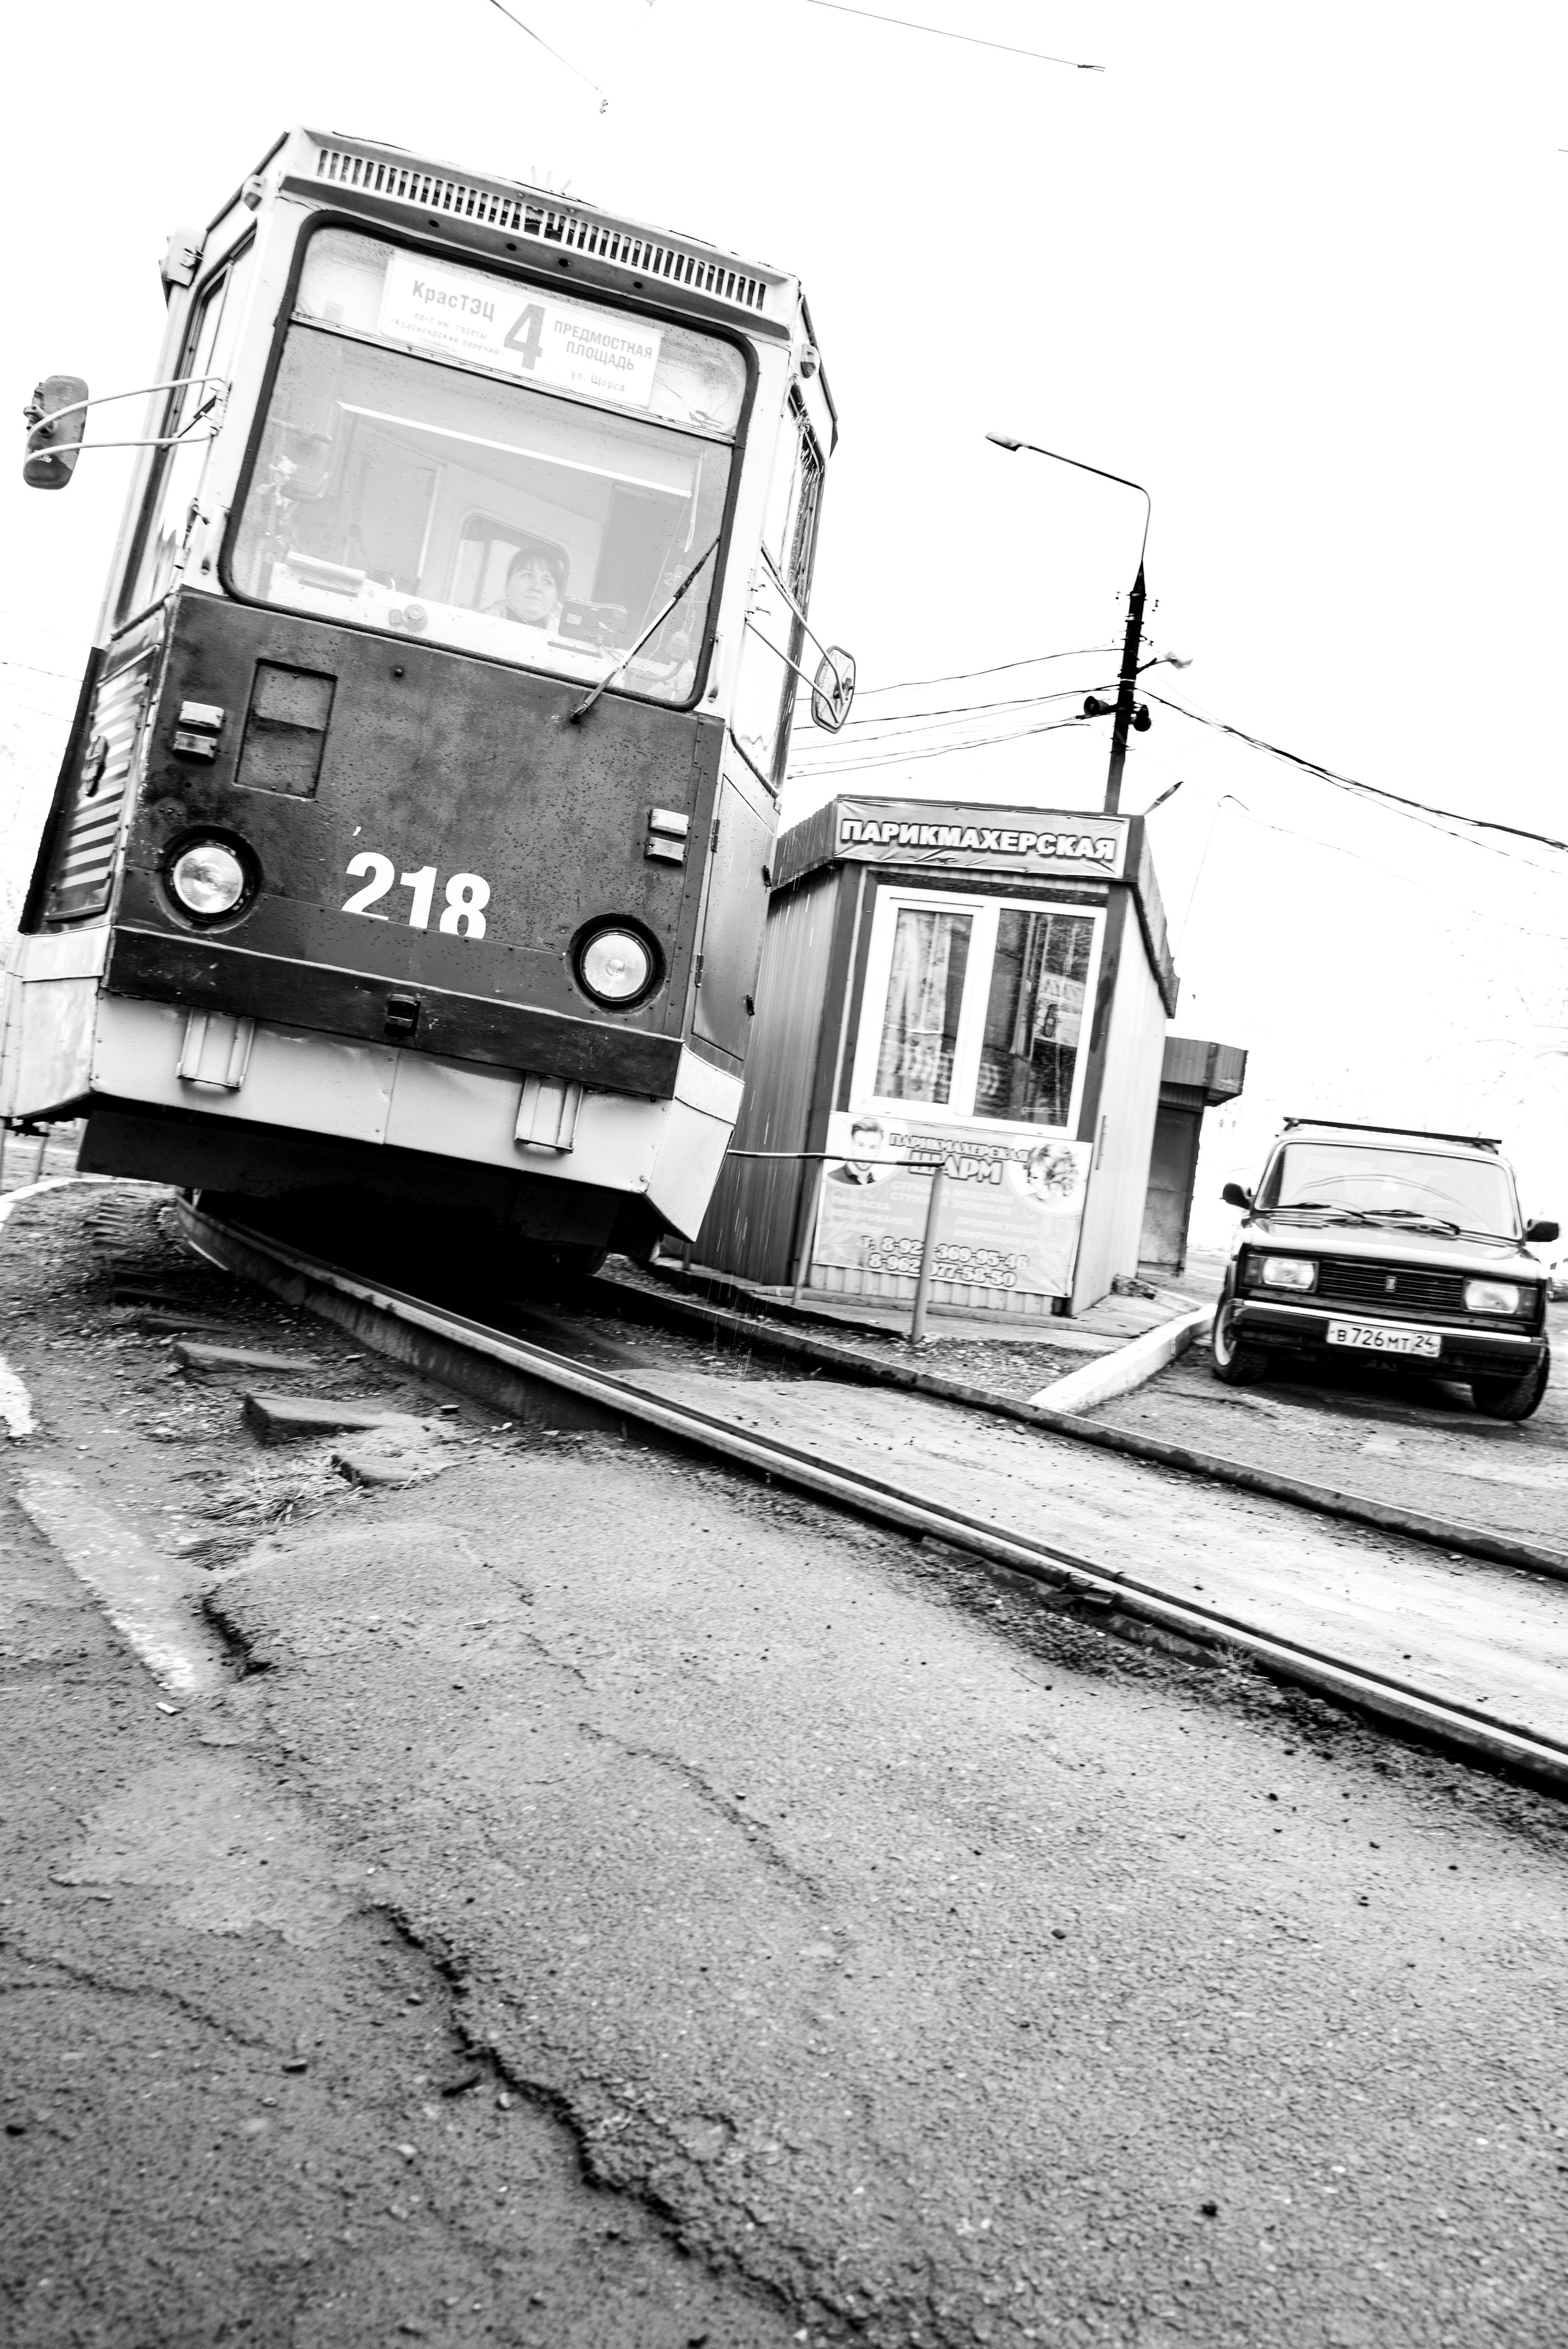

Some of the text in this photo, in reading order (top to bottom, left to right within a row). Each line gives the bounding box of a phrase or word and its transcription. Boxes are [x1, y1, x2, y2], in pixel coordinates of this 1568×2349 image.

[413, 280, 495, 323] КрасТЭЦ
[503, 303, 546, 371] 4
[554, 320, 653, 359] ПРЕДМОСТНАЯ
[566, 341, 635, 371] ПЛОЩАДЬ
[571, 371, 625, 392] ул. Щорса
[841, 818, 1117, 861] ПАРИКМАХЕРСКАЯ
[341, 851, 491, 940] 218
[889, 1133, 1030, 1163] ПАРИКМАХЕРСКАЯ
[909, 1150, 1003, 1185] ШАРМ
[880, 1236, 1030, 1270] 8-92-369-95-46
